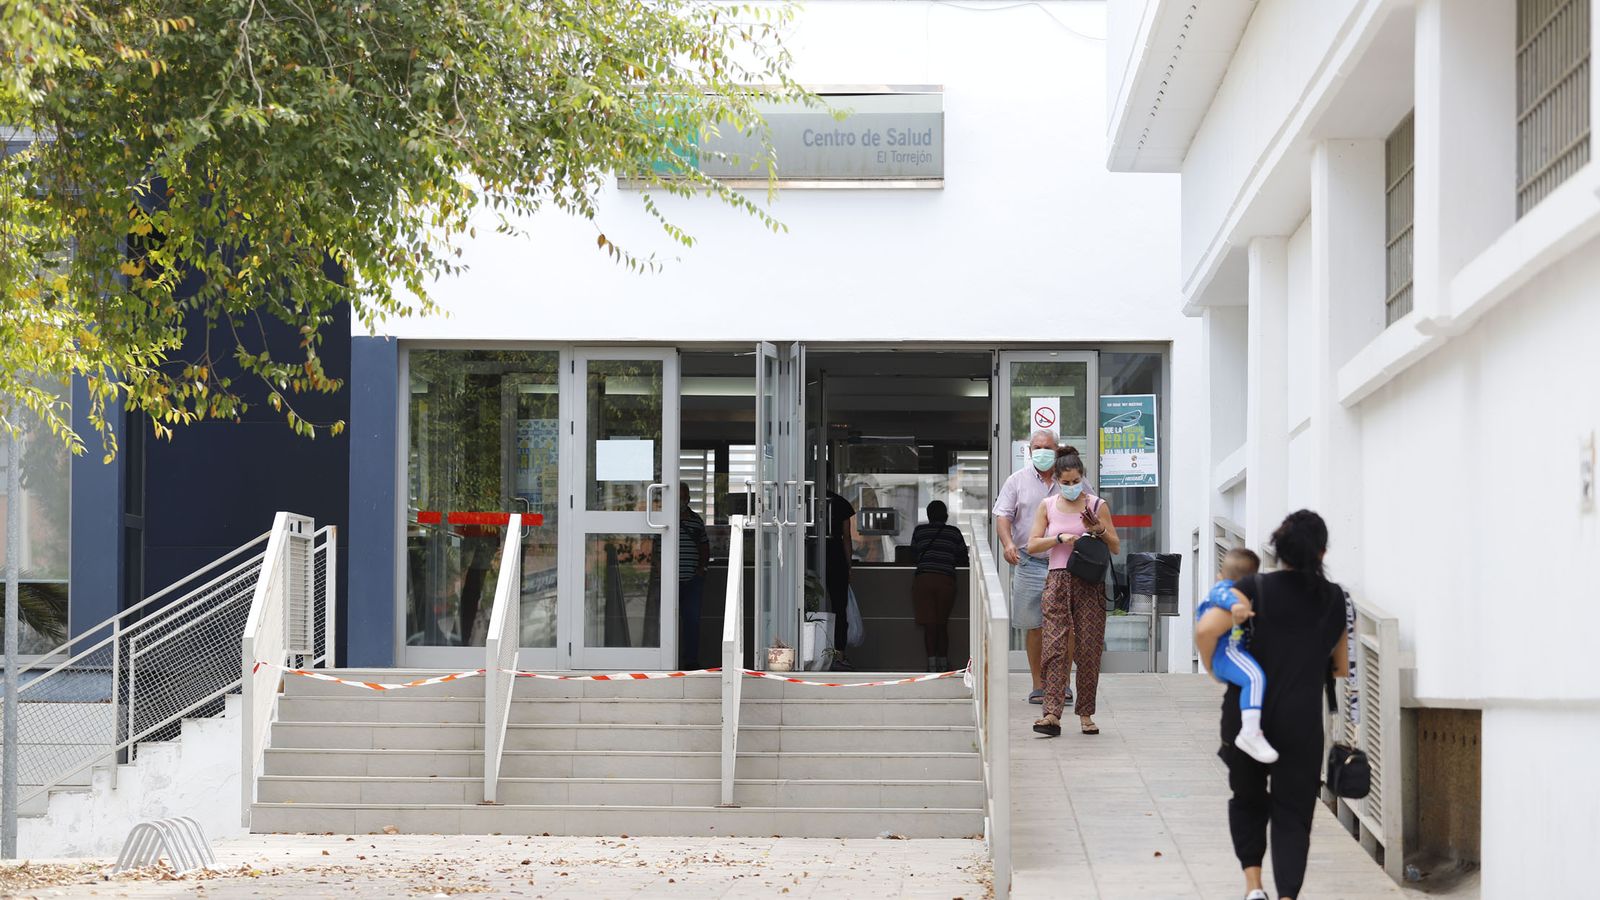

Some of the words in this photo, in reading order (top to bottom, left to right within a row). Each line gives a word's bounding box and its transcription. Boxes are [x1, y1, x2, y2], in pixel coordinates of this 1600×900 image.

[803, 128, 856, 147] Centro
[861, 128, 881, 147] de
[887, 127, 932, 146] Salud
[877, 150, 887, 163] El
[891, 150, 932, 165] Torrejón
[1104, 433, 1144, 448] GRIPE
